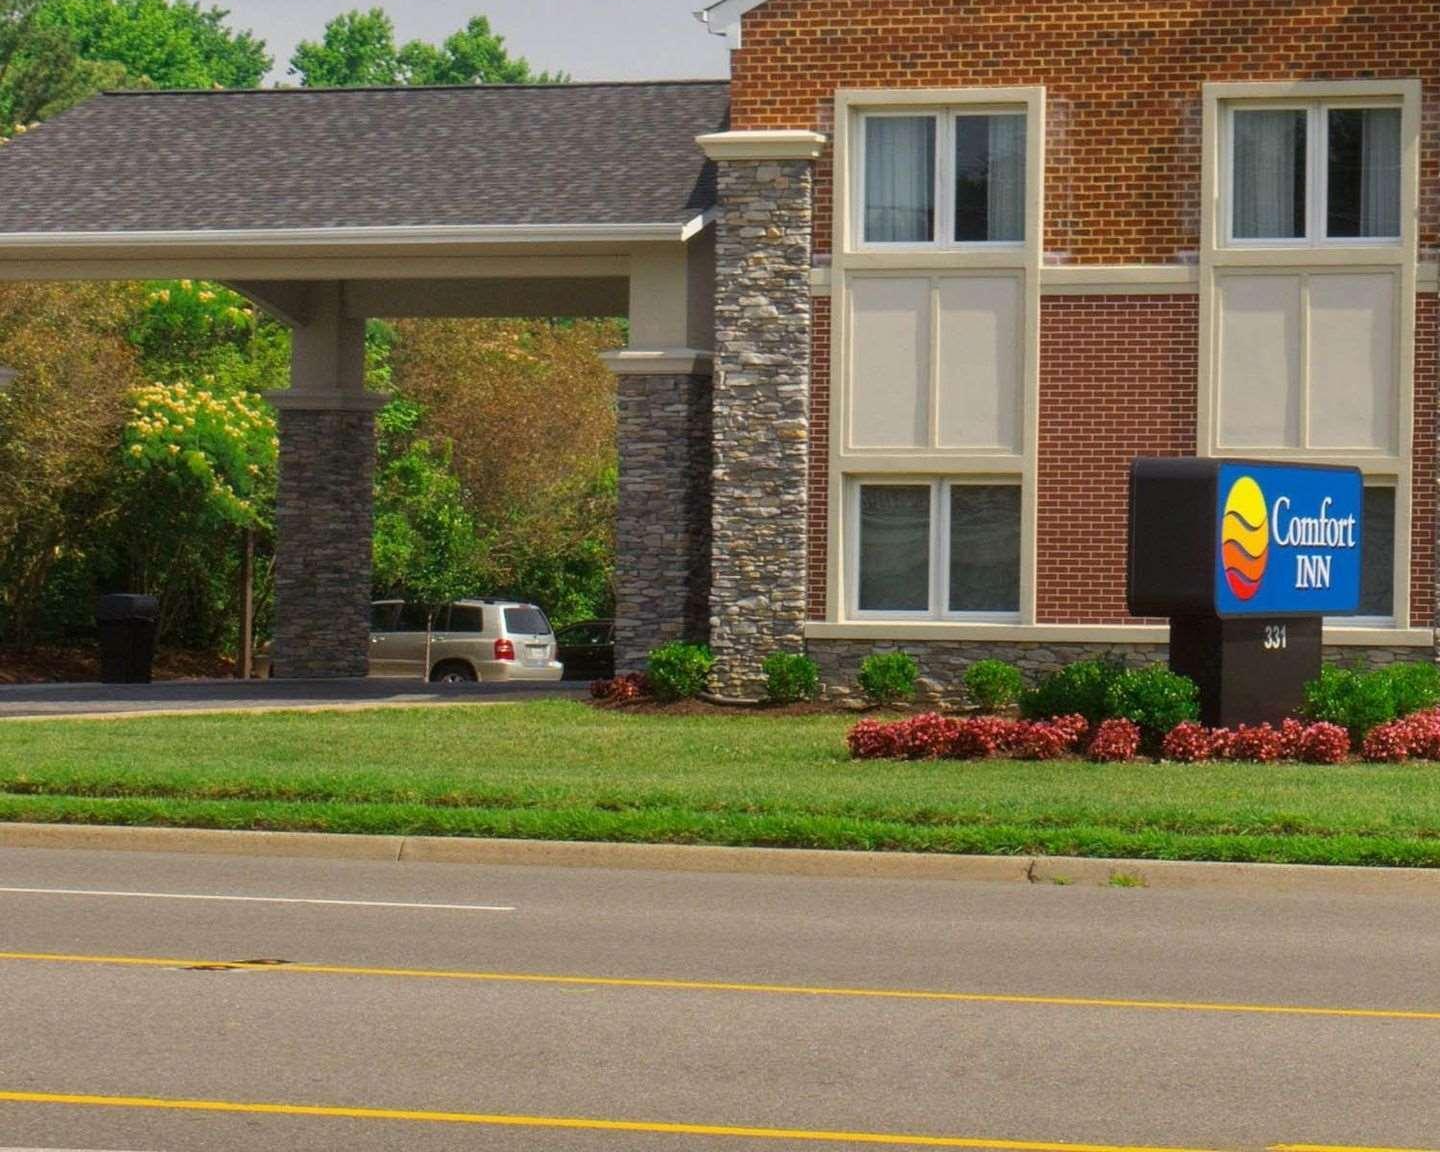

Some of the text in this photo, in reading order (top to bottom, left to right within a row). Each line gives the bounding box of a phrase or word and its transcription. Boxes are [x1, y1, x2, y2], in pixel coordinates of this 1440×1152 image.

[1272, 496, 1356, 548] Comfort
[1295, 555, 1332, 589] INN
[1264, 625, 1287, 649] 331
